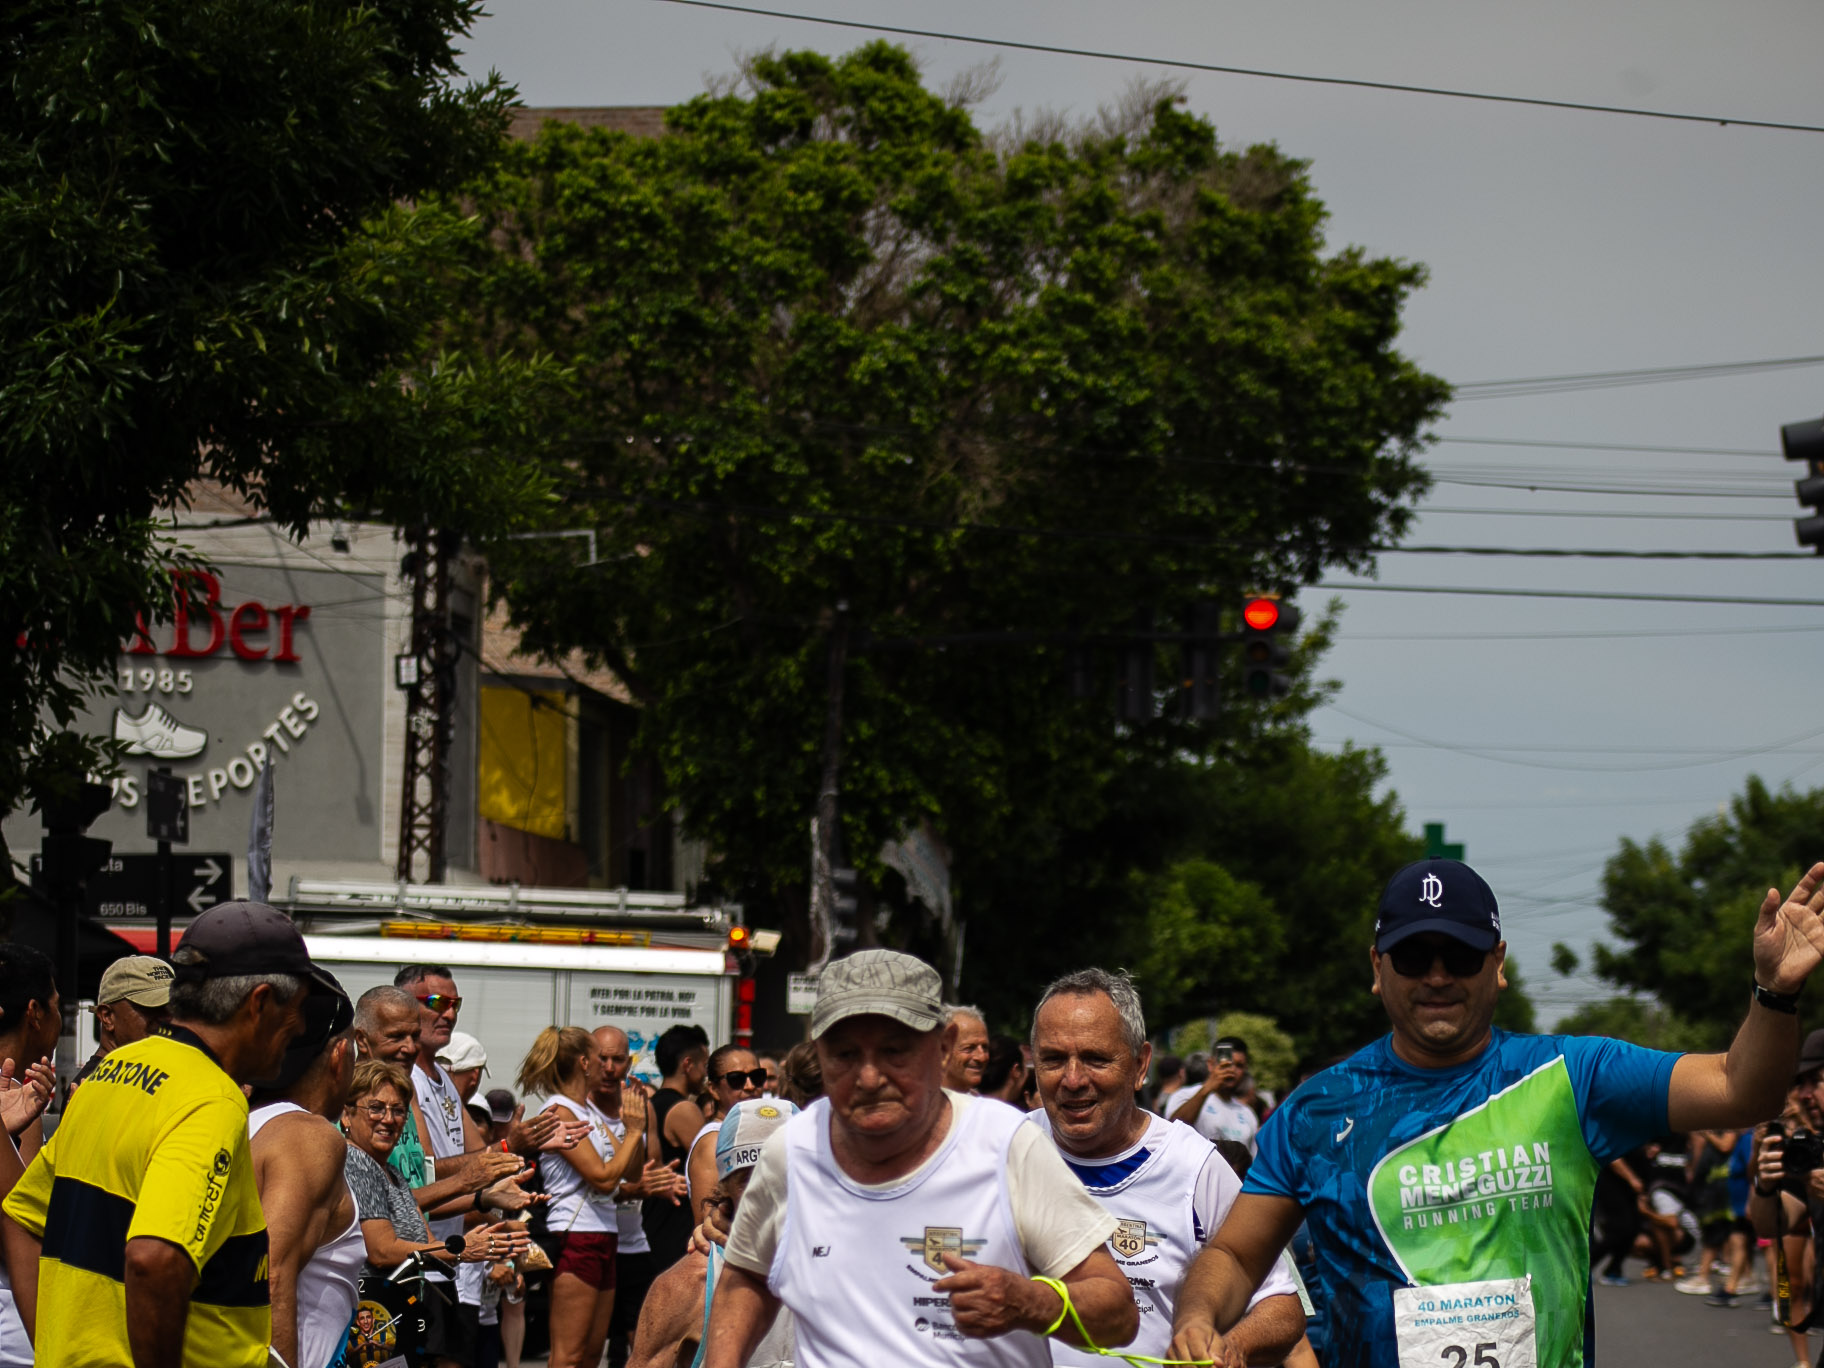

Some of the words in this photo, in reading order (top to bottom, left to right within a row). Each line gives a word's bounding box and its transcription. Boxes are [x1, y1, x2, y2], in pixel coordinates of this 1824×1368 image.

[121, 668, 193, 693] 1985
[187, 692, 320, 807] EPORTES
[100, 903, 124, 916] 650
[126, 903, 147, 916] Bis
[736, 1149, 761, 1166] ARG
[1399, 1141, 1550, 1186] CRISTIAN
[1400, 1164, 1553, 1209] MENEGUZZI
[195, 1171, 223, 1242] unicef
[1403, 1202, 1496, 1230] RUNNING
[1508, 1193, 1553, 1212] TEAM
[1119, 1239, 1138, 1251] 40
[932, 1252, 944, 1265] 4
[1126, 1255, 1159, 1266] GRANEROS
[913, 1297, 952, 1307] HIPER
[1138, 1305, 1154, 1314] cipal
[1418, 1301, 1435, 1312] 40
[1440, 1294, 1516, 1311] MARATON
[417, 1319, 426, 1332] 3
[1415, 1315, 1463, 1327] EMPALME
[1467, 1310, 1519, 1323] GRANEROS
